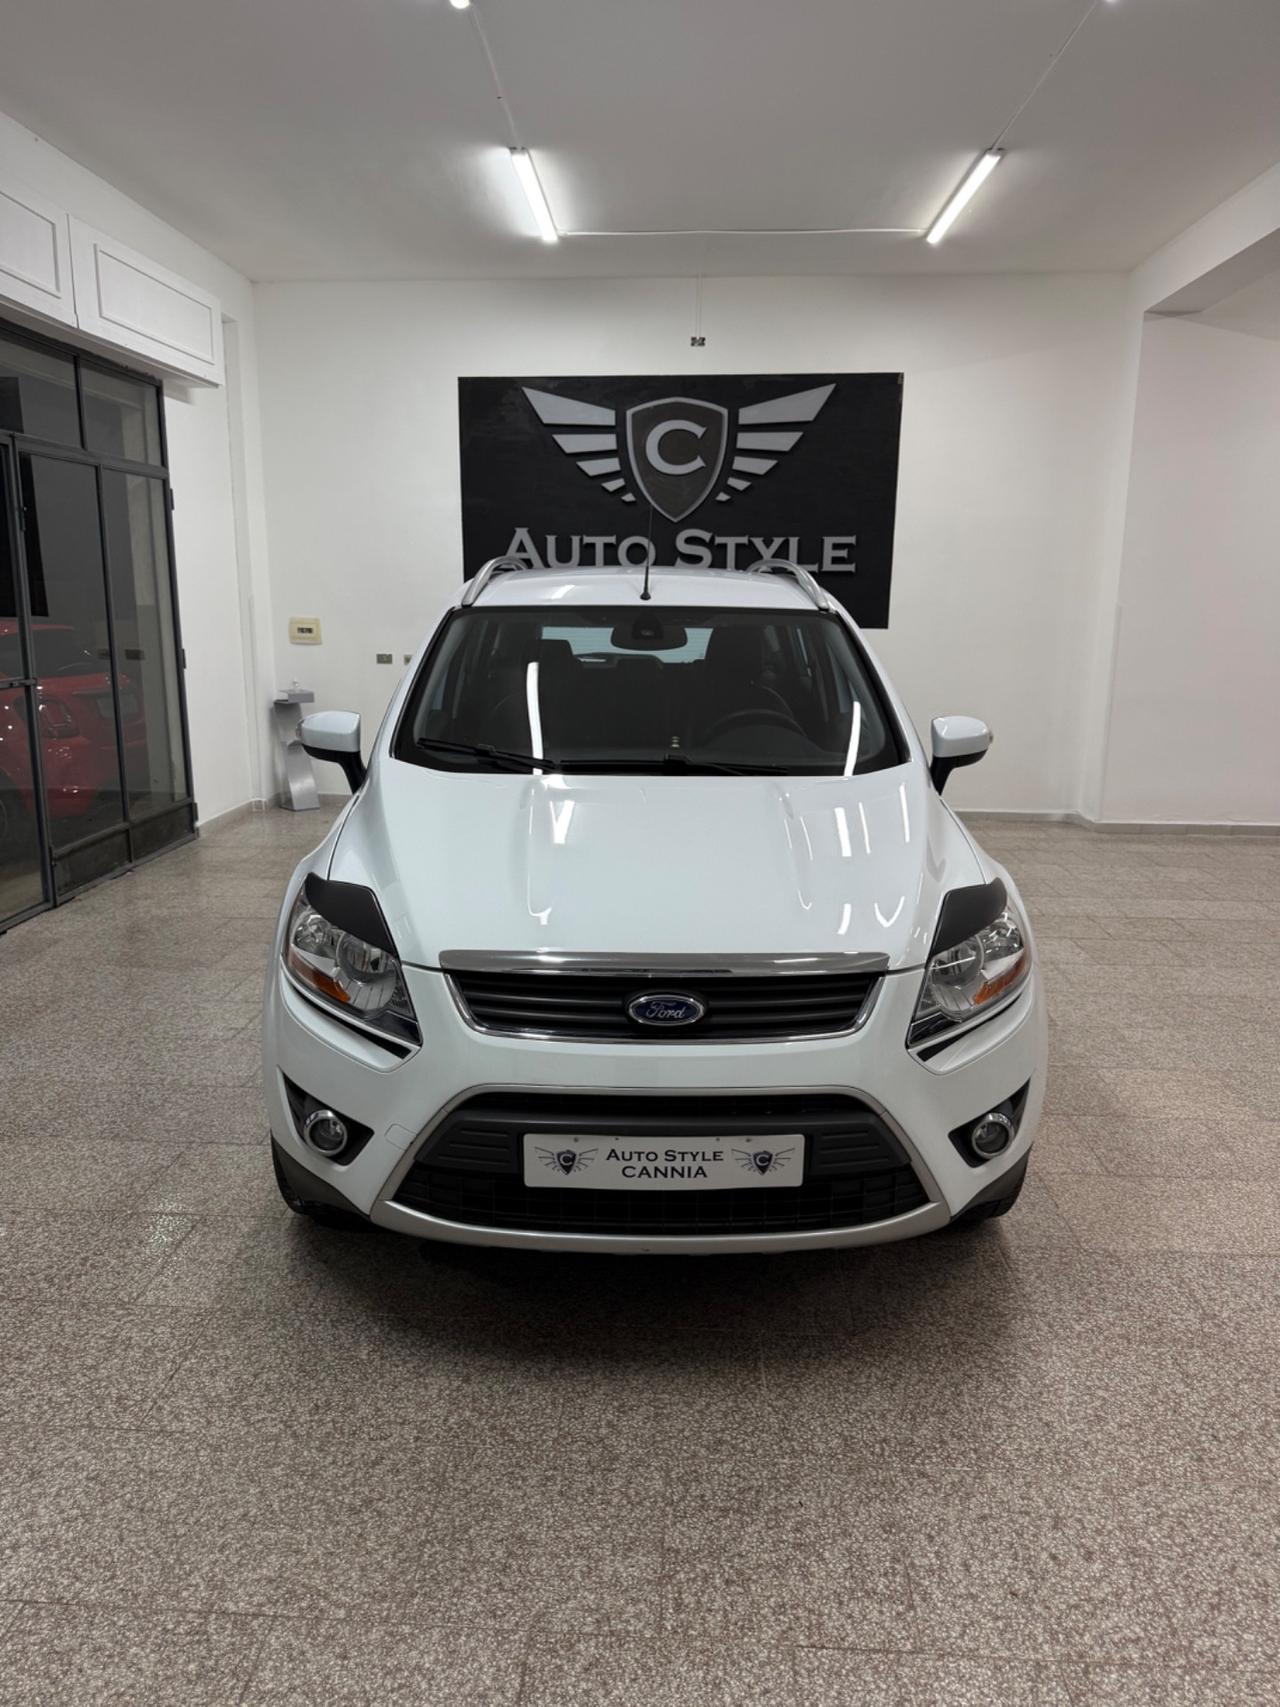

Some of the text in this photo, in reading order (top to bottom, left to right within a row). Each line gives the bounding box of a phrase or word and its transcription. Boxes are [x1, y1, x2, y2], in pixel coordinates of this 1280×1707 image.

[645, 419, 707, 475] C
[504, 527, 856, 573] AUTO STYLE
[646, 1001, 686, 1018] Ford
[606, 1149, 724, 1162] AUTO STYLE
[621, 1165, 708, 1179] CANNIA
